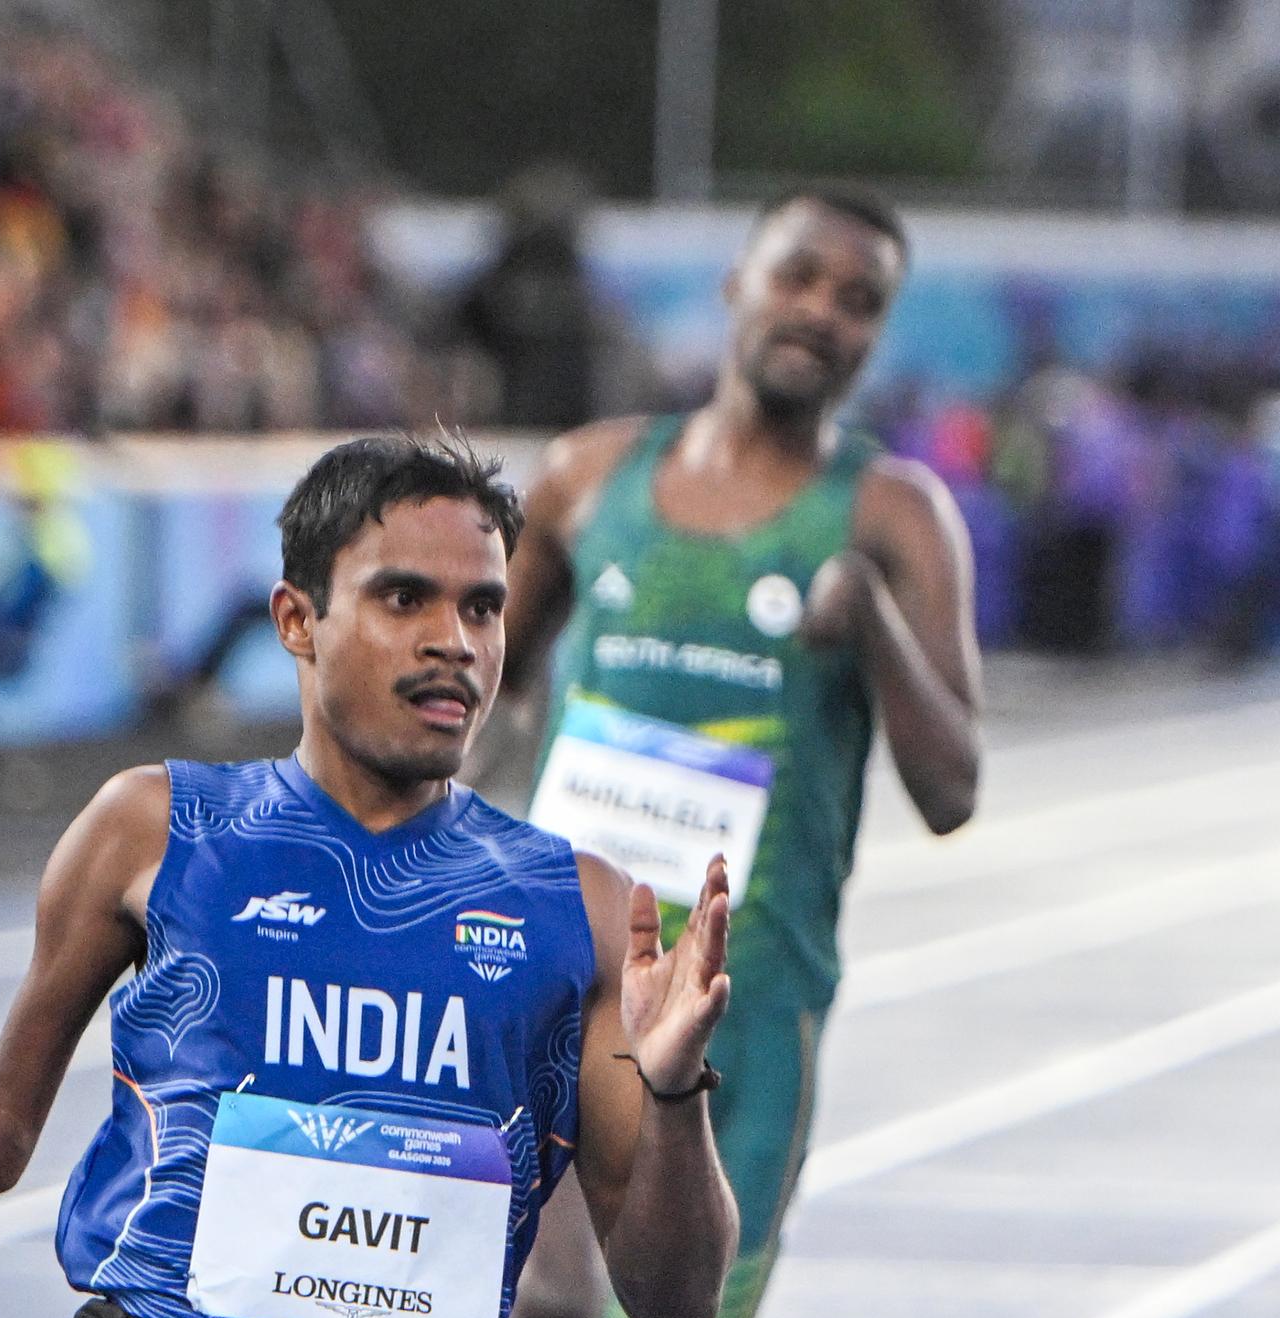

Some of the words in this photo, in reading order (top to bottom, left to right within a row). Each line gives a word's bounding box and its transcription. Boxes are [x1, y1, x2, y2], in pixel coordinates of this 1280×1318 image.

[231, 891, 326, 926] JSW
[455, 924, 527, 952] INDIA
[264, 975, 471, 1090] INDIA
[381, 1125, 461, 1145] commonwealth
[404, 1139, 441, 1153] games
[388, 1150, 433, 1165] GLASGOW
[298, 1201, 430, 1254] GAVIT
[271, 1271, 432, 1314] LONGINES
